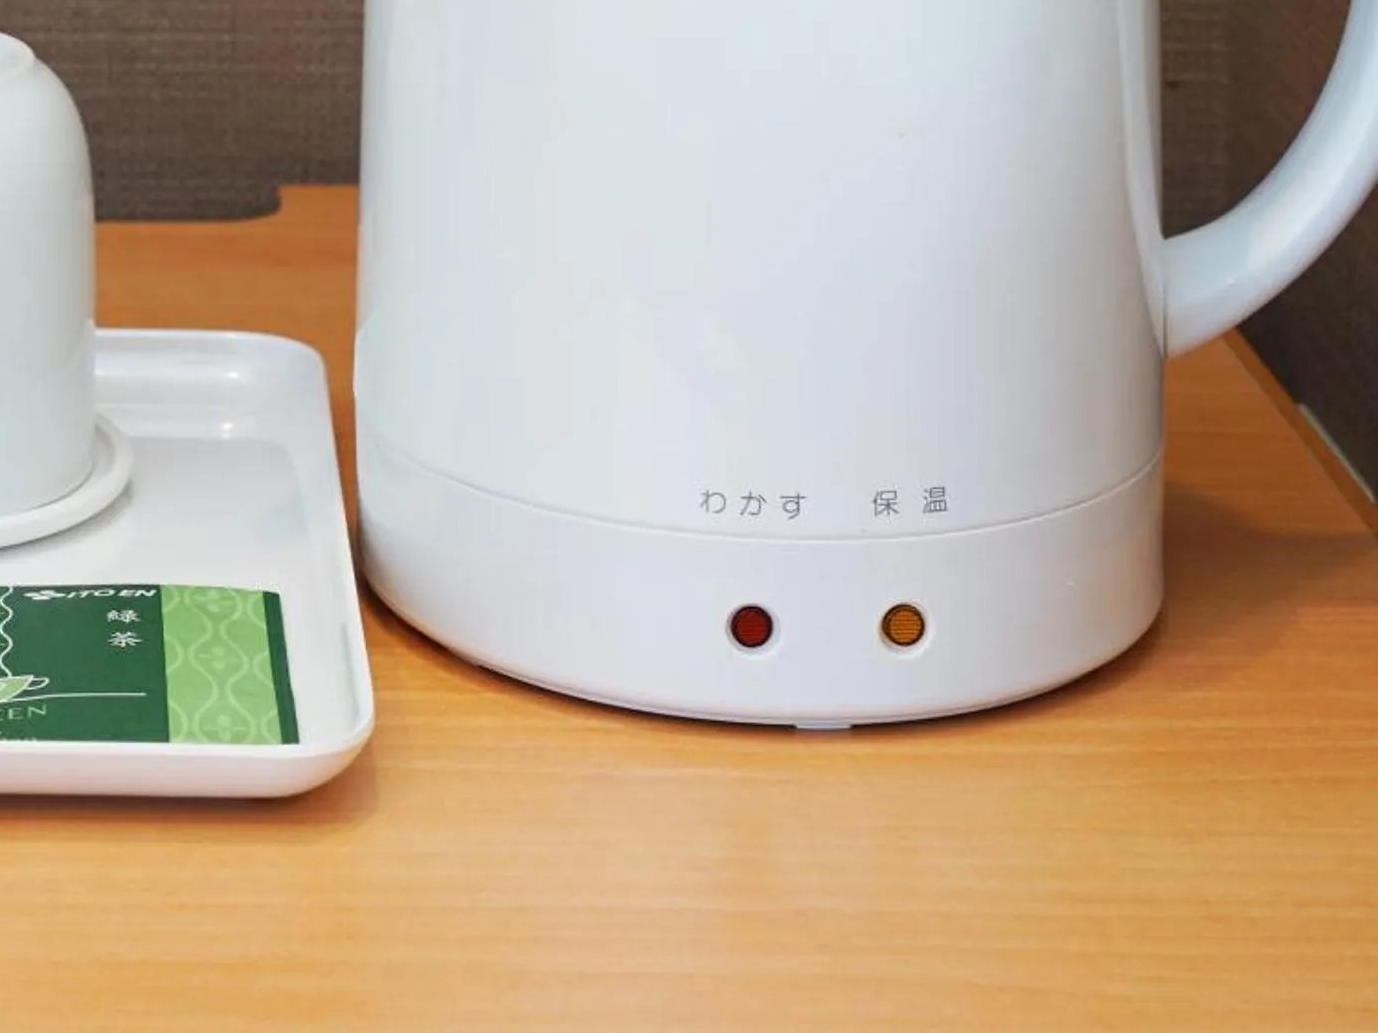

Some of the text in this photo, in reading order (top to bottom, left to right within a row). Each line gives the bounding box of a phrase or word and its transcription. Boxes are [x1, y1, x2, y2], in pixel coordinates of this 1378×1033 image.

[699, 489, 806, 519] わかす
[872, 486, 948, 516] 保温
